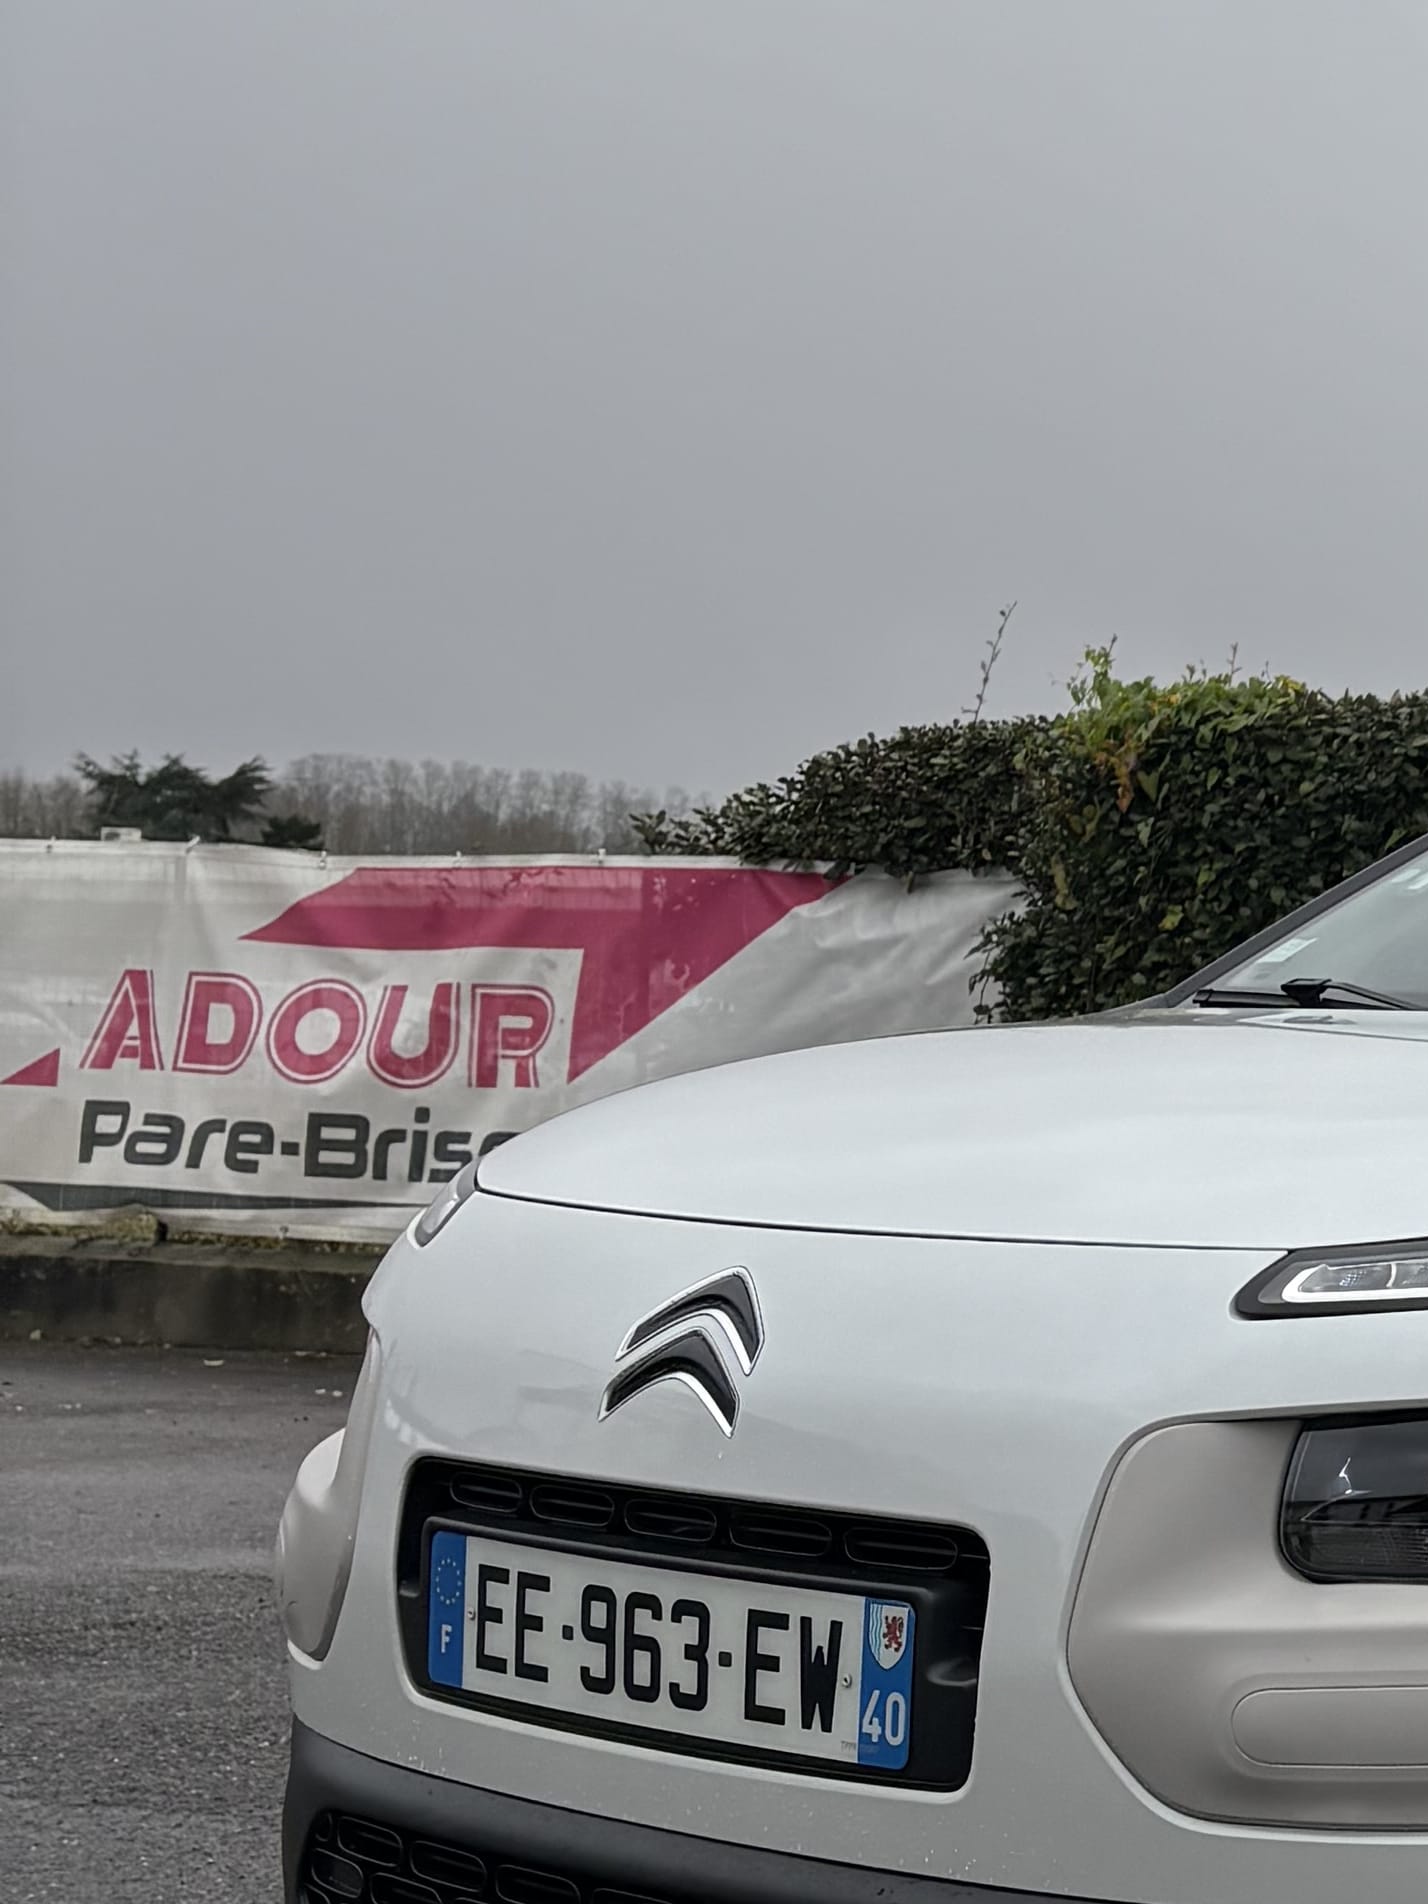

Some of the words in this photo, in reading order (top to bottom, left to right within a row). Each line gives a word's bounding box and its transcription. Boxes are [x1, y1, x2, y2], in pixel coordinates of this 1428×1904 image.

[80, 969, 554, 1088] ADOUR
[440, 1624, 453, 1654] F
[861, 1690, 905, 1747] 40
